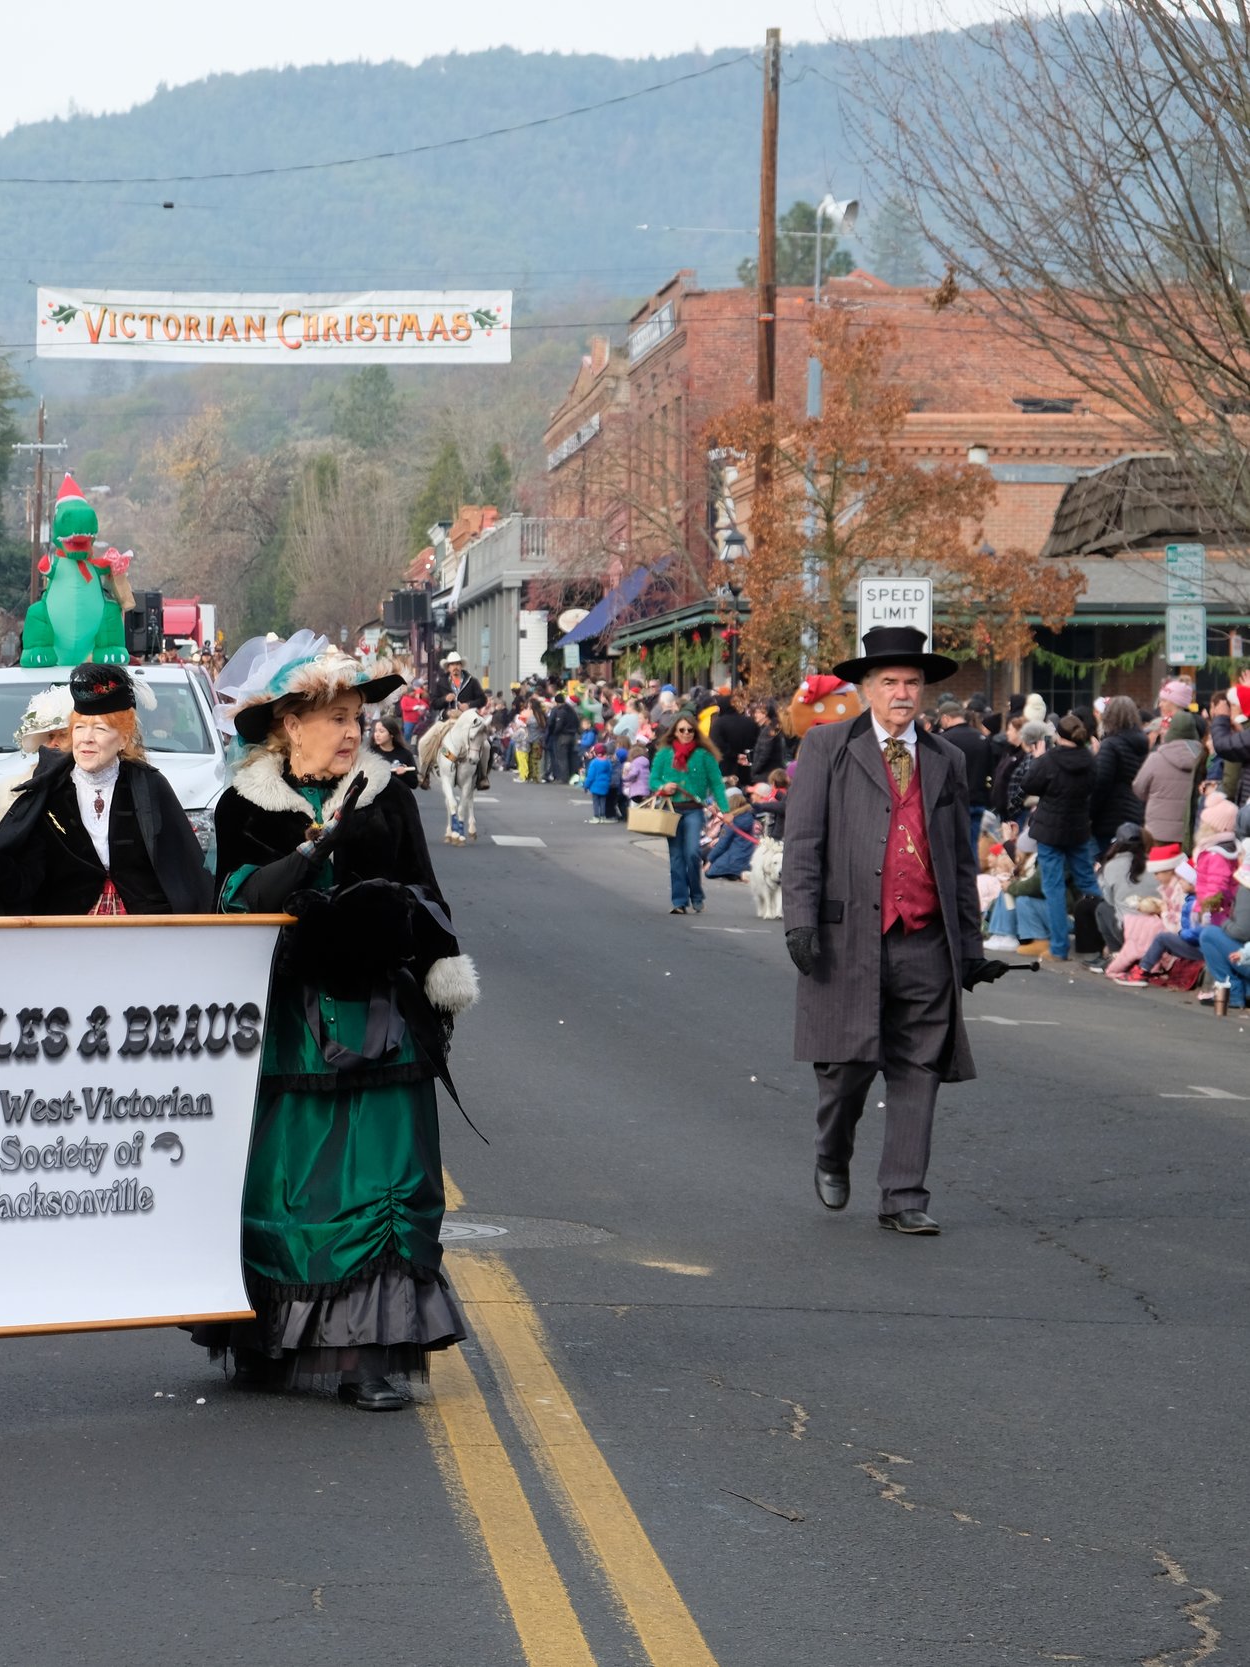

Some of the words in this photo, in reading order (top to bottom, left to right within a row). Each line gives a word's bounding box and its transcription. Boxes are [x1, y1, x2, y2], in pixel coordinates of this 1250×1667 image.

[83, 306, 267, 344] VICTORIAN
[276, 309, 472, 350] CHRISTMAS
[866, 588, 925, 602] SPEED
[872, 606, 919, 620] LIMIT
[77, 1005, 111, 1057] &
[117, 1002, 262, 1056] BEAUS
[0, 1086, 214, 1124] West-Victorian
[113, 1130, 146, 1167] of
